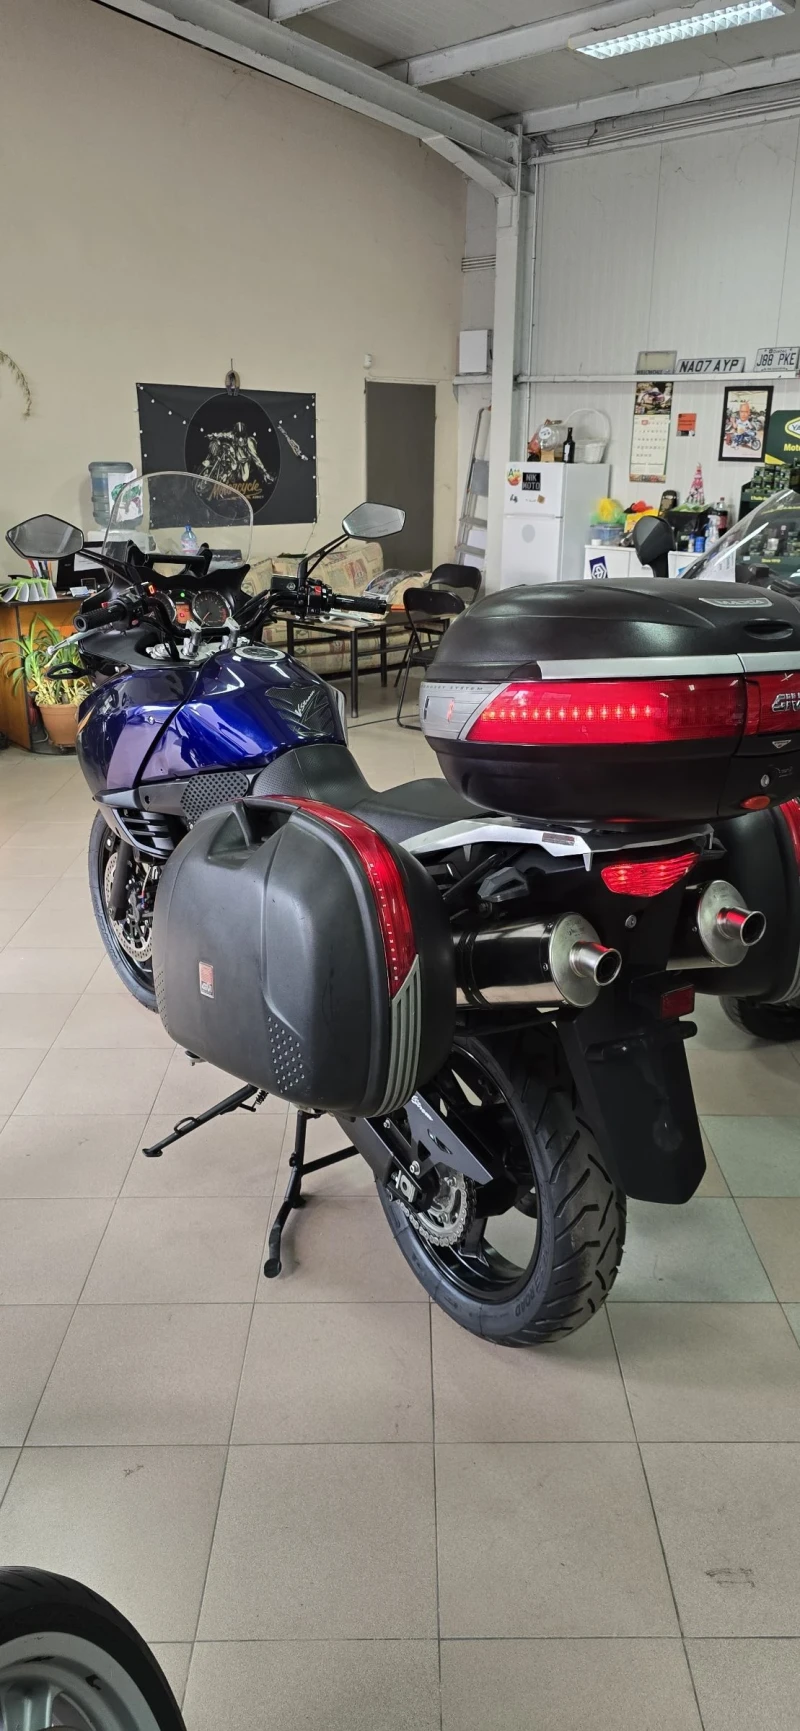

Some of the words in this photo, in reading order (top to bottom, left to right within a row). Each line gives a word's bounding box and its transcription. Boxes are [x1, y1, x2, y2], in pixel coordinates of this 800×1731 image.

[679, 360, 712, 373] NA07
[713, 359, 739, 372] AYP
[757, 354, 774, 367] J88
[777, 352, 797, 366] PKE
[525, 473, 538, 482] NIK
[208, 479, 263, 501] Motorcycle
[521, 481, 541, 490] MOTO
